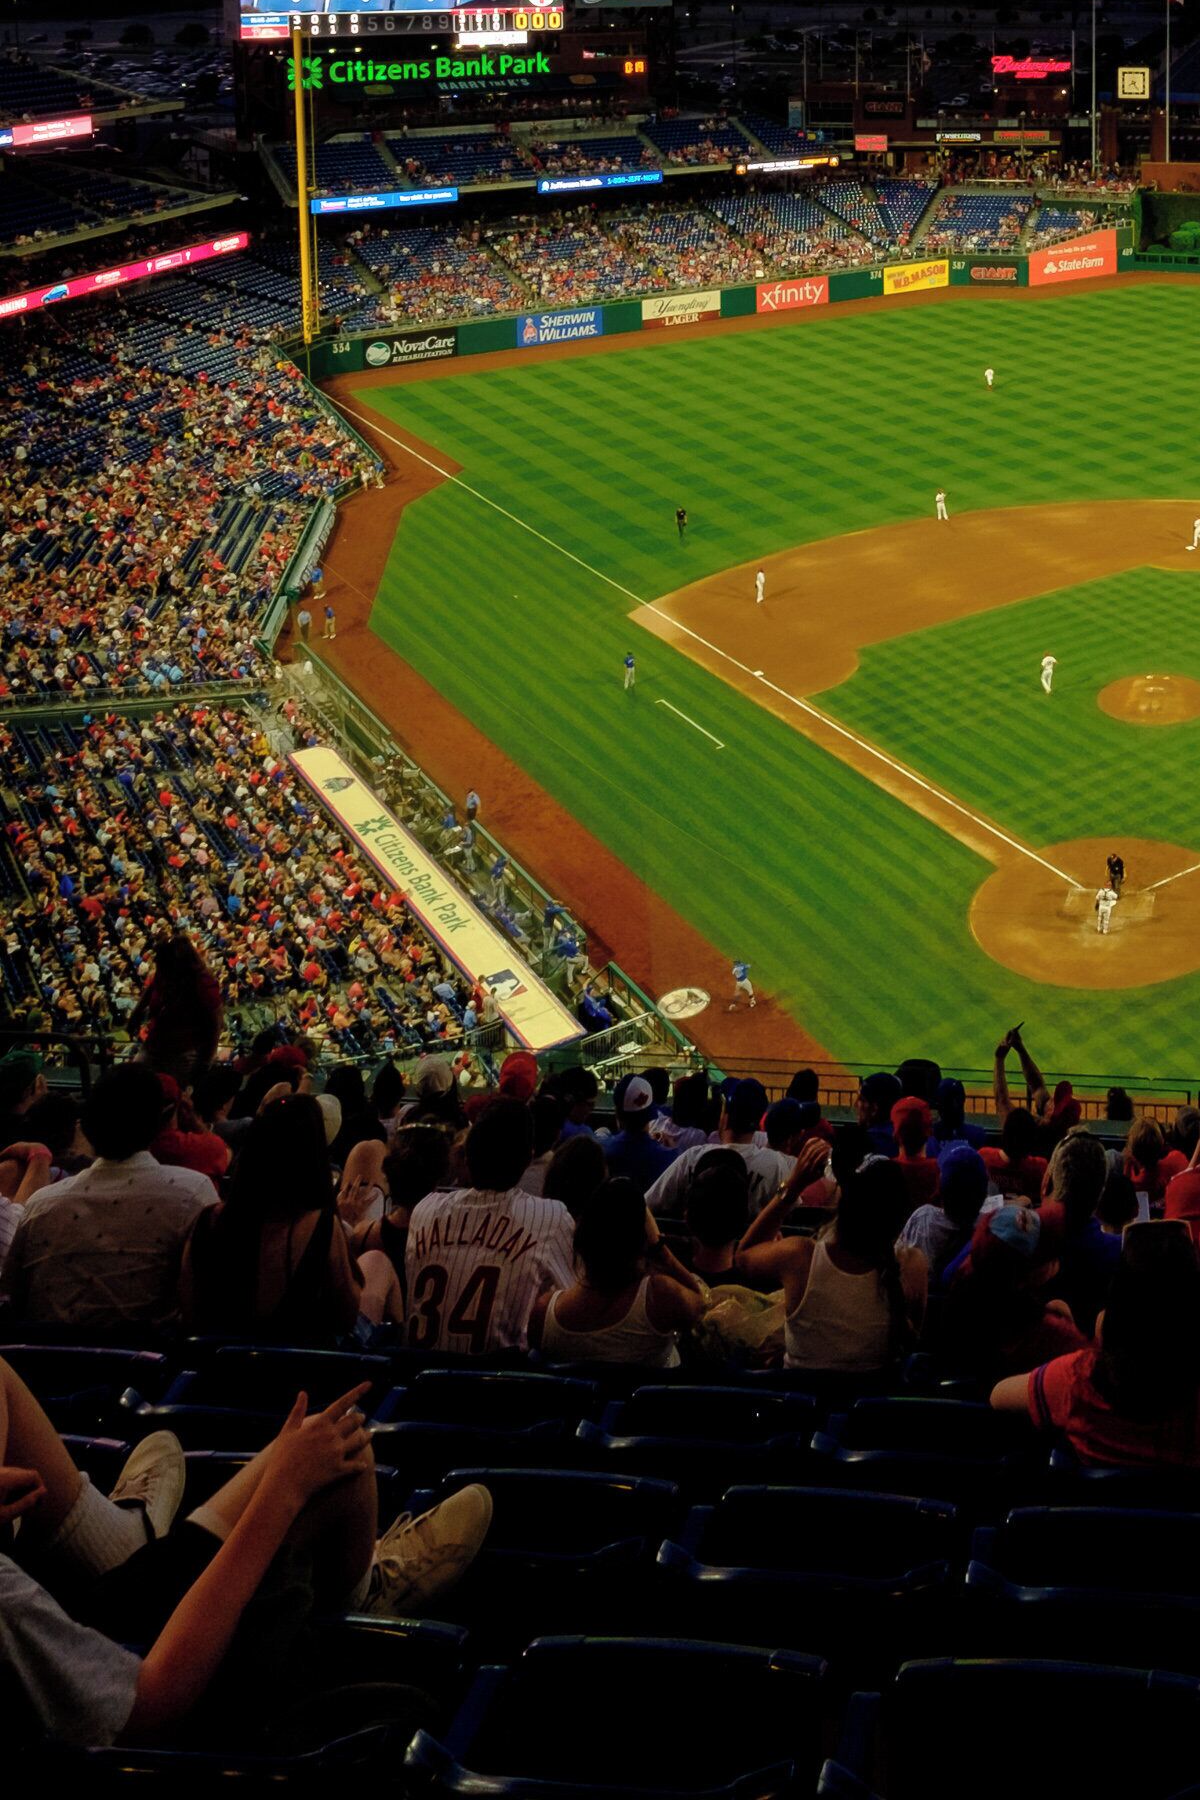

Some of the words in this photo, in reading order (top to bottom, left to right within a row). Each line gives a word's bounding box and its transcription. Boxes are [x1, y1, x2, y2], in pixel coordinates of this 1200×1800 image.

[515, 13, 528, 30] 0
[532, 12, 544, 29] 0
[548, 12, 560, 29] 0
[329, 60, 431, 82] Citizens
[436, 54, 496, 78] Bank
[500, 51, 550, 75] Park
[438, 81, 487, 90] HARRY
[970, 267, 1017, 281] GIANT
[761, 283, 824, 310] xfinity
[652, 299, 710, 315] Yuengling
[539, 312, 595, 328] SHERWIN
[664, 313, 700, 326] LAGER
[332, 342, 350, 354] 334
[392, 336, 455, 354] NovaCare
[375, 833, 414, 880] Citizens
[409, 872, 439, 906] Bank
[433, 903, 467, 933] Park
[415, 1212, 538, 1263] HALLADAY
[407, 1264, 502, 1355] 34
